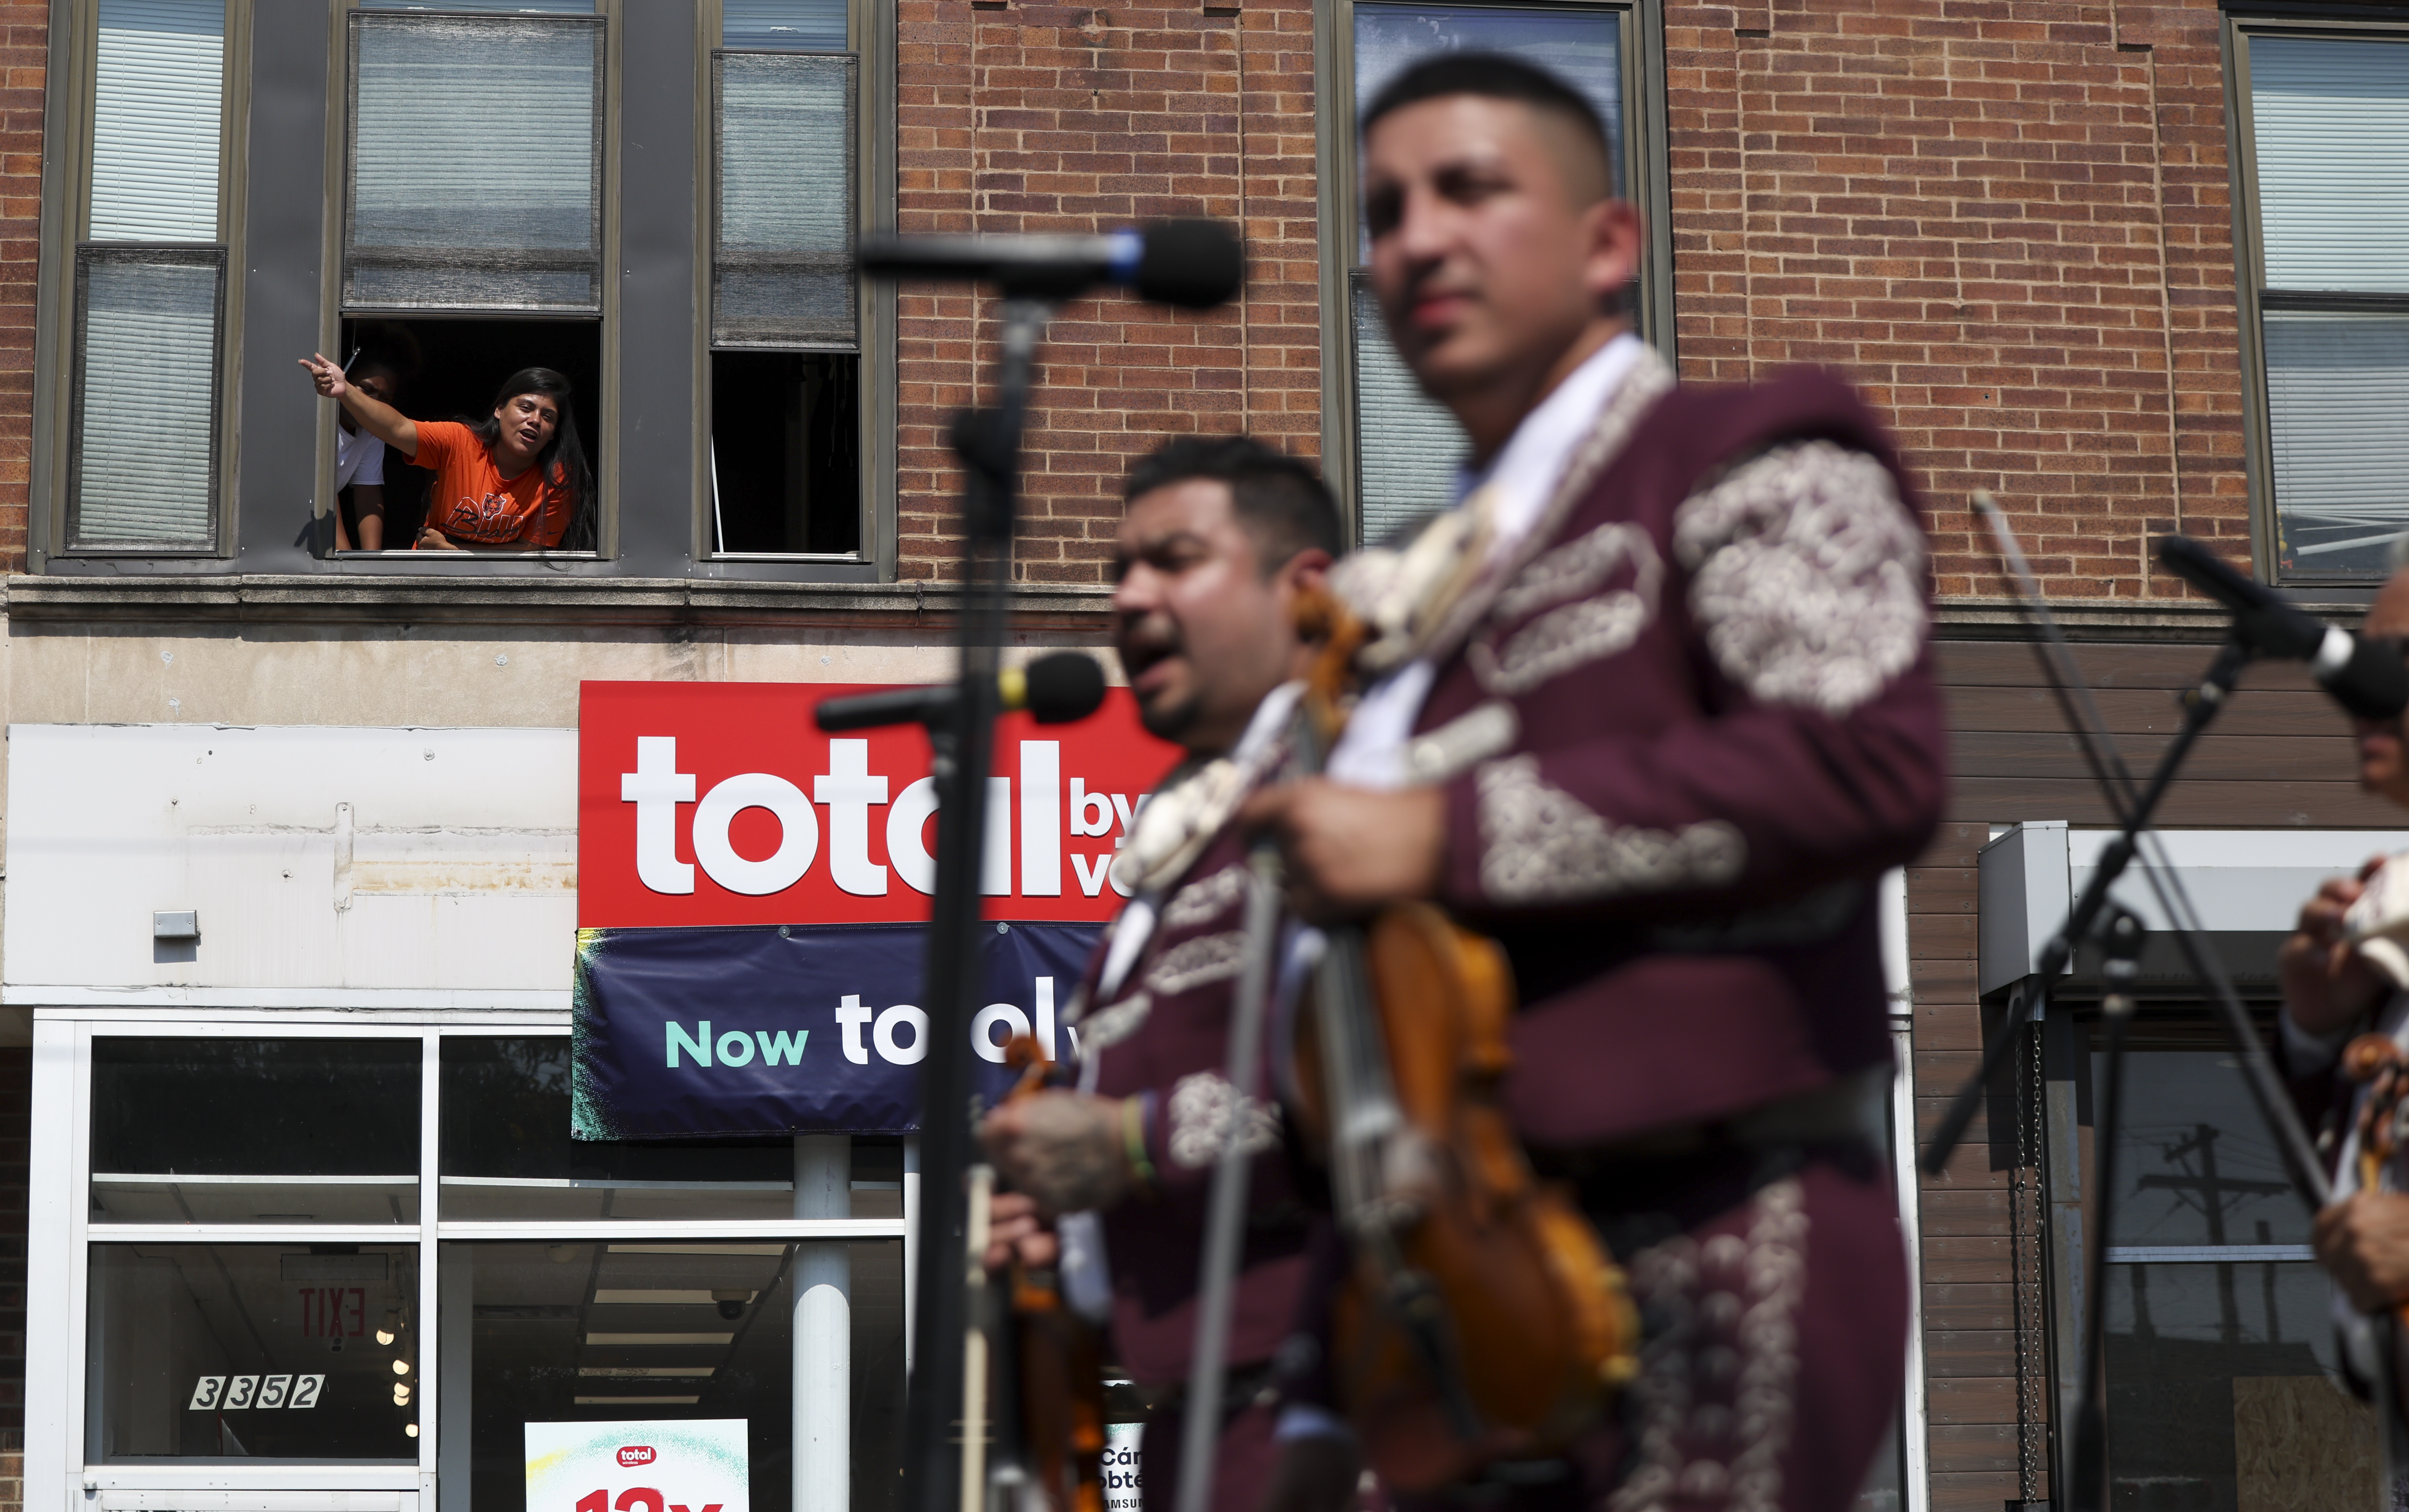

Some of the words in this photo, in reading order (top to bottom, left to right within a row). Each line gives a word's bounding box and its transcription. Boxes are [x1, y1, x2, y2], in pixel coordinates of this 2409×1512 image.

[666, 1021, 809, 1068] Now
[196, 1376, 318, 1407] 3352
[621, 1448, 651, 1460] total
